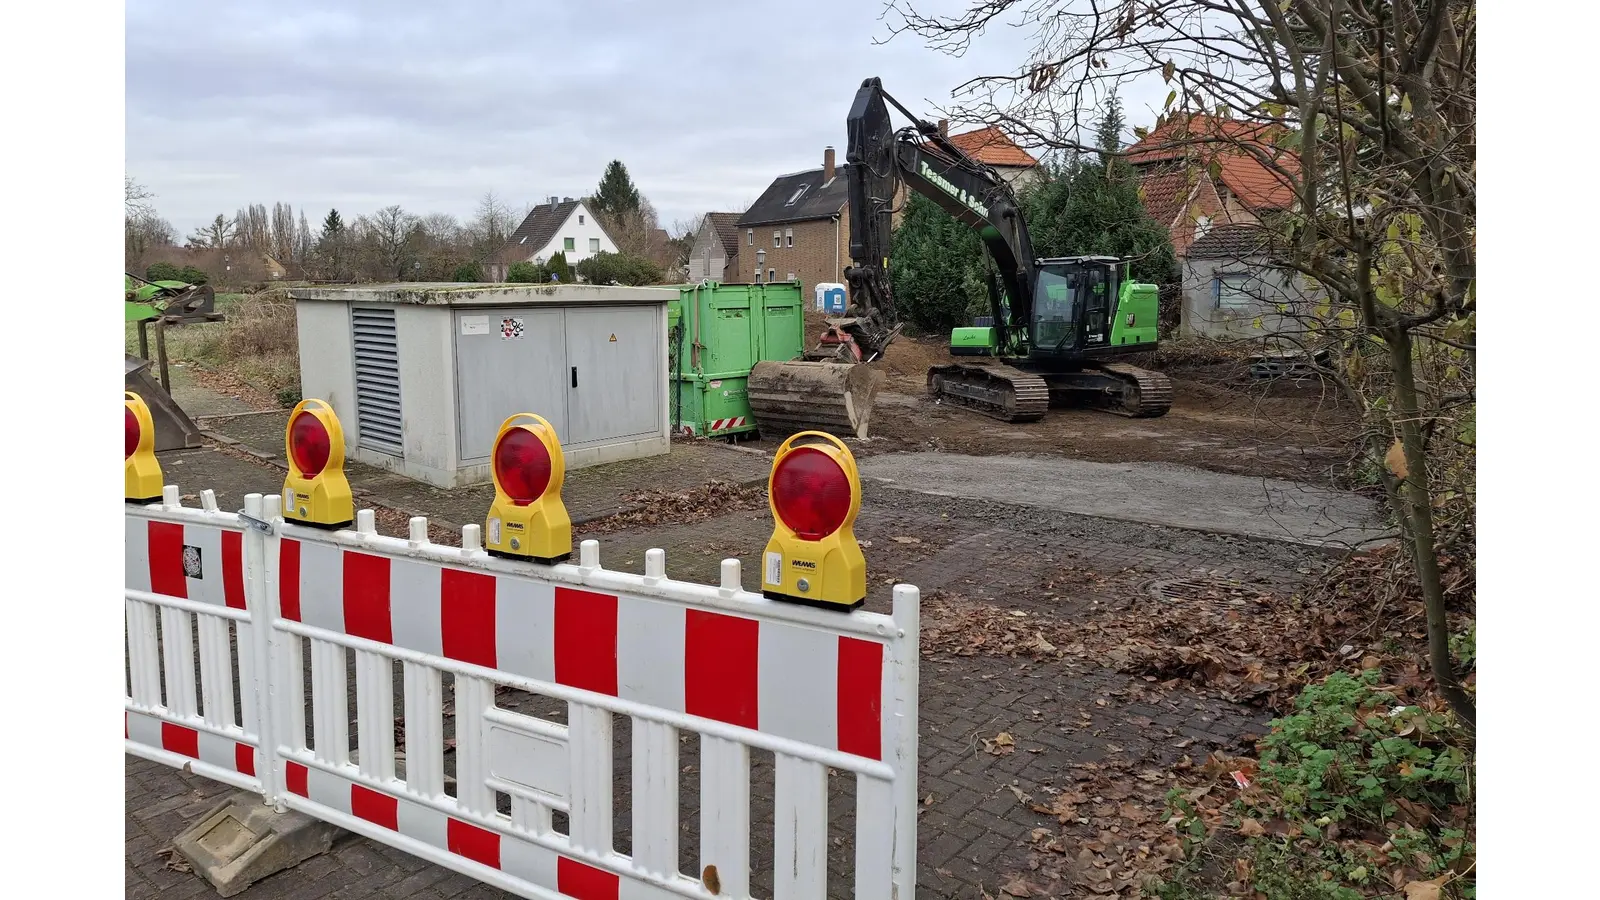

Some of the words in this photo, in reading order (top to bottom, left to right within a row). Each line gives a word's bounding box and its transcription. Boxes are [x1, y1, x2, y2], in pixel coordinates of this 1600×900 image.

[920, 160, 959, 197] Tessmer
[960, 189, 967, 203] &
[791, 559, 816, 569] WEMAS
